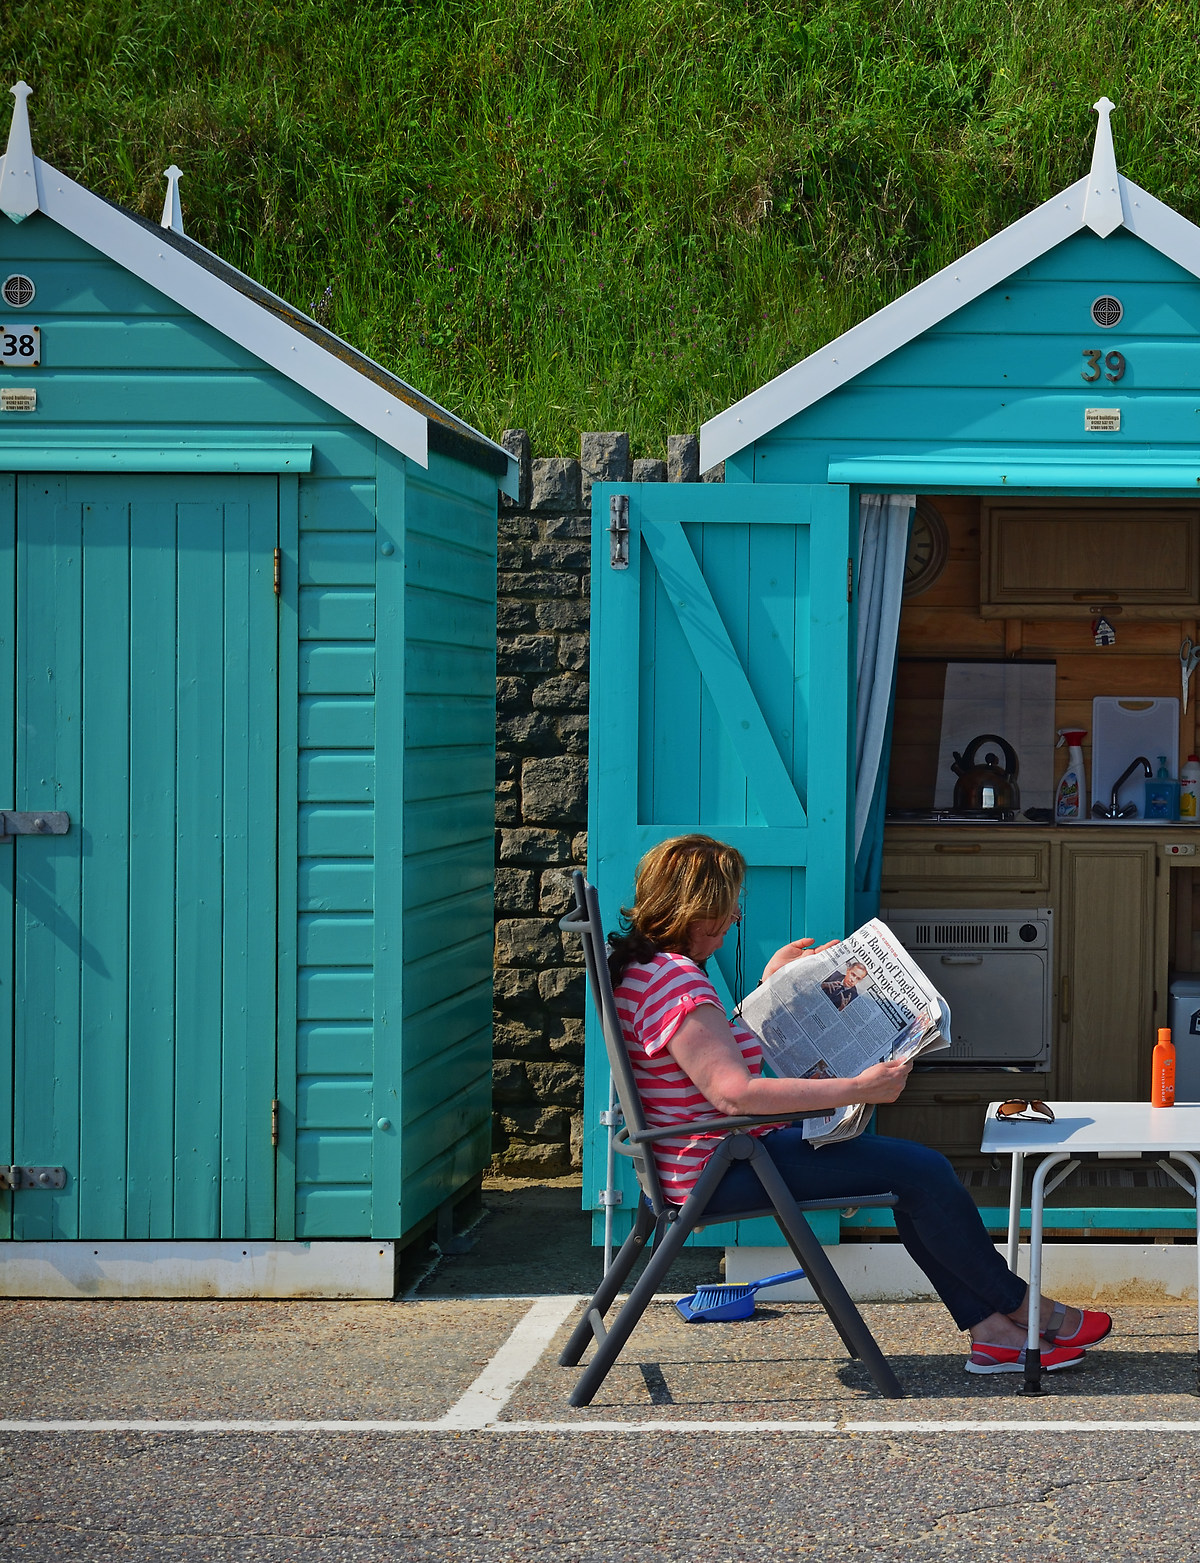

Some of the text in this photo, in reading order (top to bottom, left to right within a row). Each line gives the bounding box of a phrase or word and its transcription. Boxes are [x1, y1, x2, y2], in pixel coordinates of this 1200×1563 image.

[3, 334, 35, 357] 38
[1081, 349, 1126, 382] 39
[853, 944, 876, 970] joins
[873, 966, 901, 1001] Project
[896, 998, 916, 1020] Fear
[867, 937, 889, 966] Bank
[886, 961, 899, 973] of
[893, 972, 927, 1011] England
